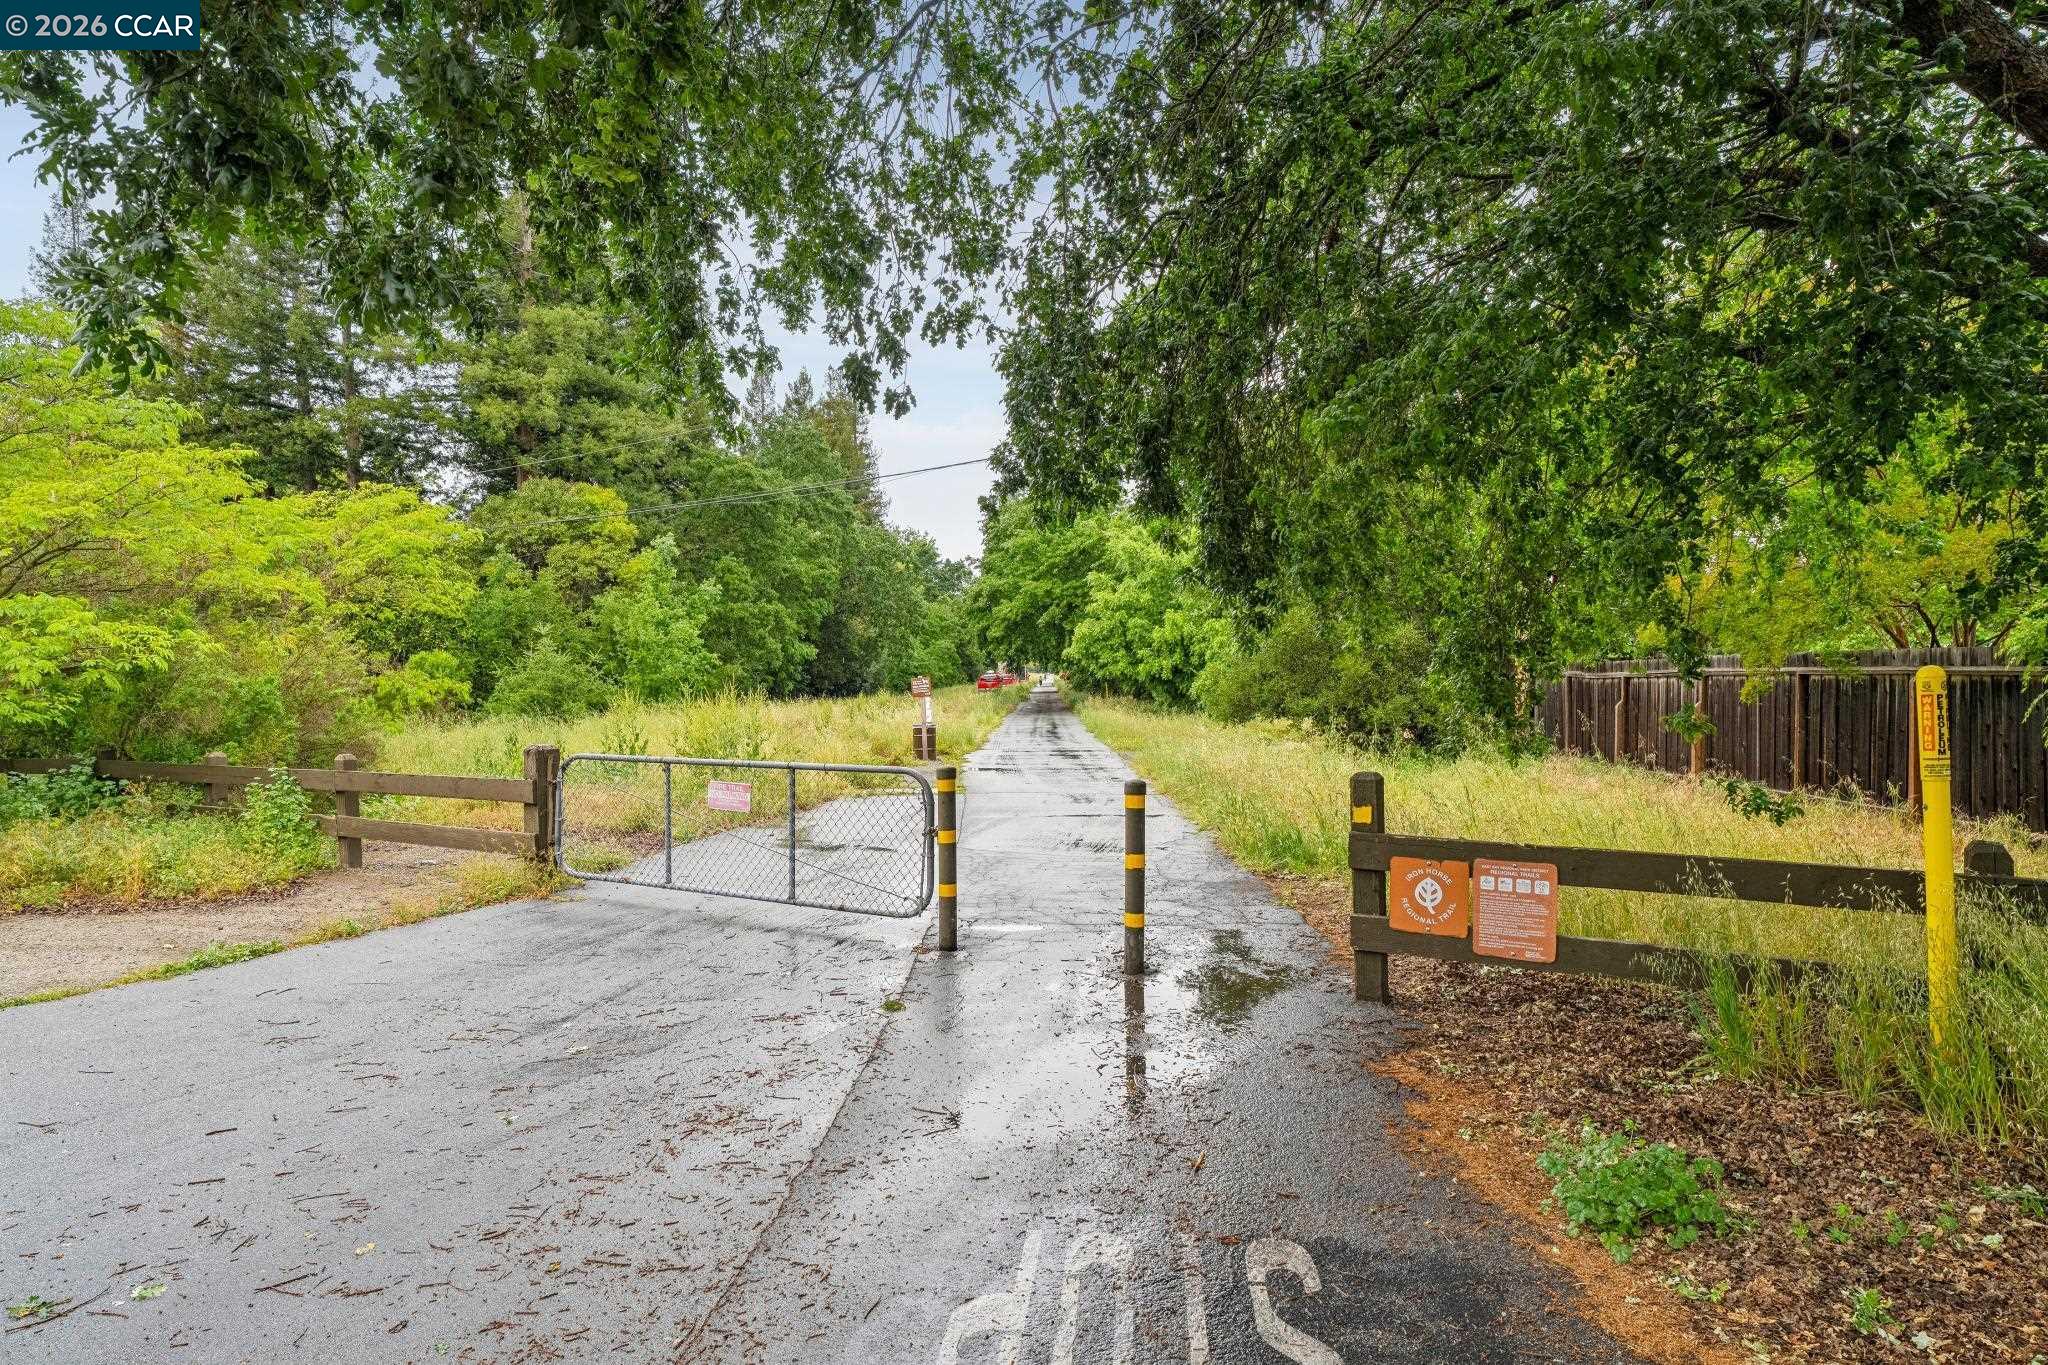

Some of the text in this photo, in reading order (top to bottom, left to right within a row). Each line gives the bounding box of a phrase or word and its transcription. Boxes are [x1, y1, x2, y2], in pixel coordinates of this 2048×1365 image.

[1922, 695, 1933, 750] WARNING
[1937, 694, 1946, 755] PETROLEUM
[1405, 868, 1453, 885] IRON HORSE
[1490, 869, 1519, 877] REGIONAL
[1401, 897, 1438, 925] REGIONAL
[1440, 903, 1457, 922] TRAIL
